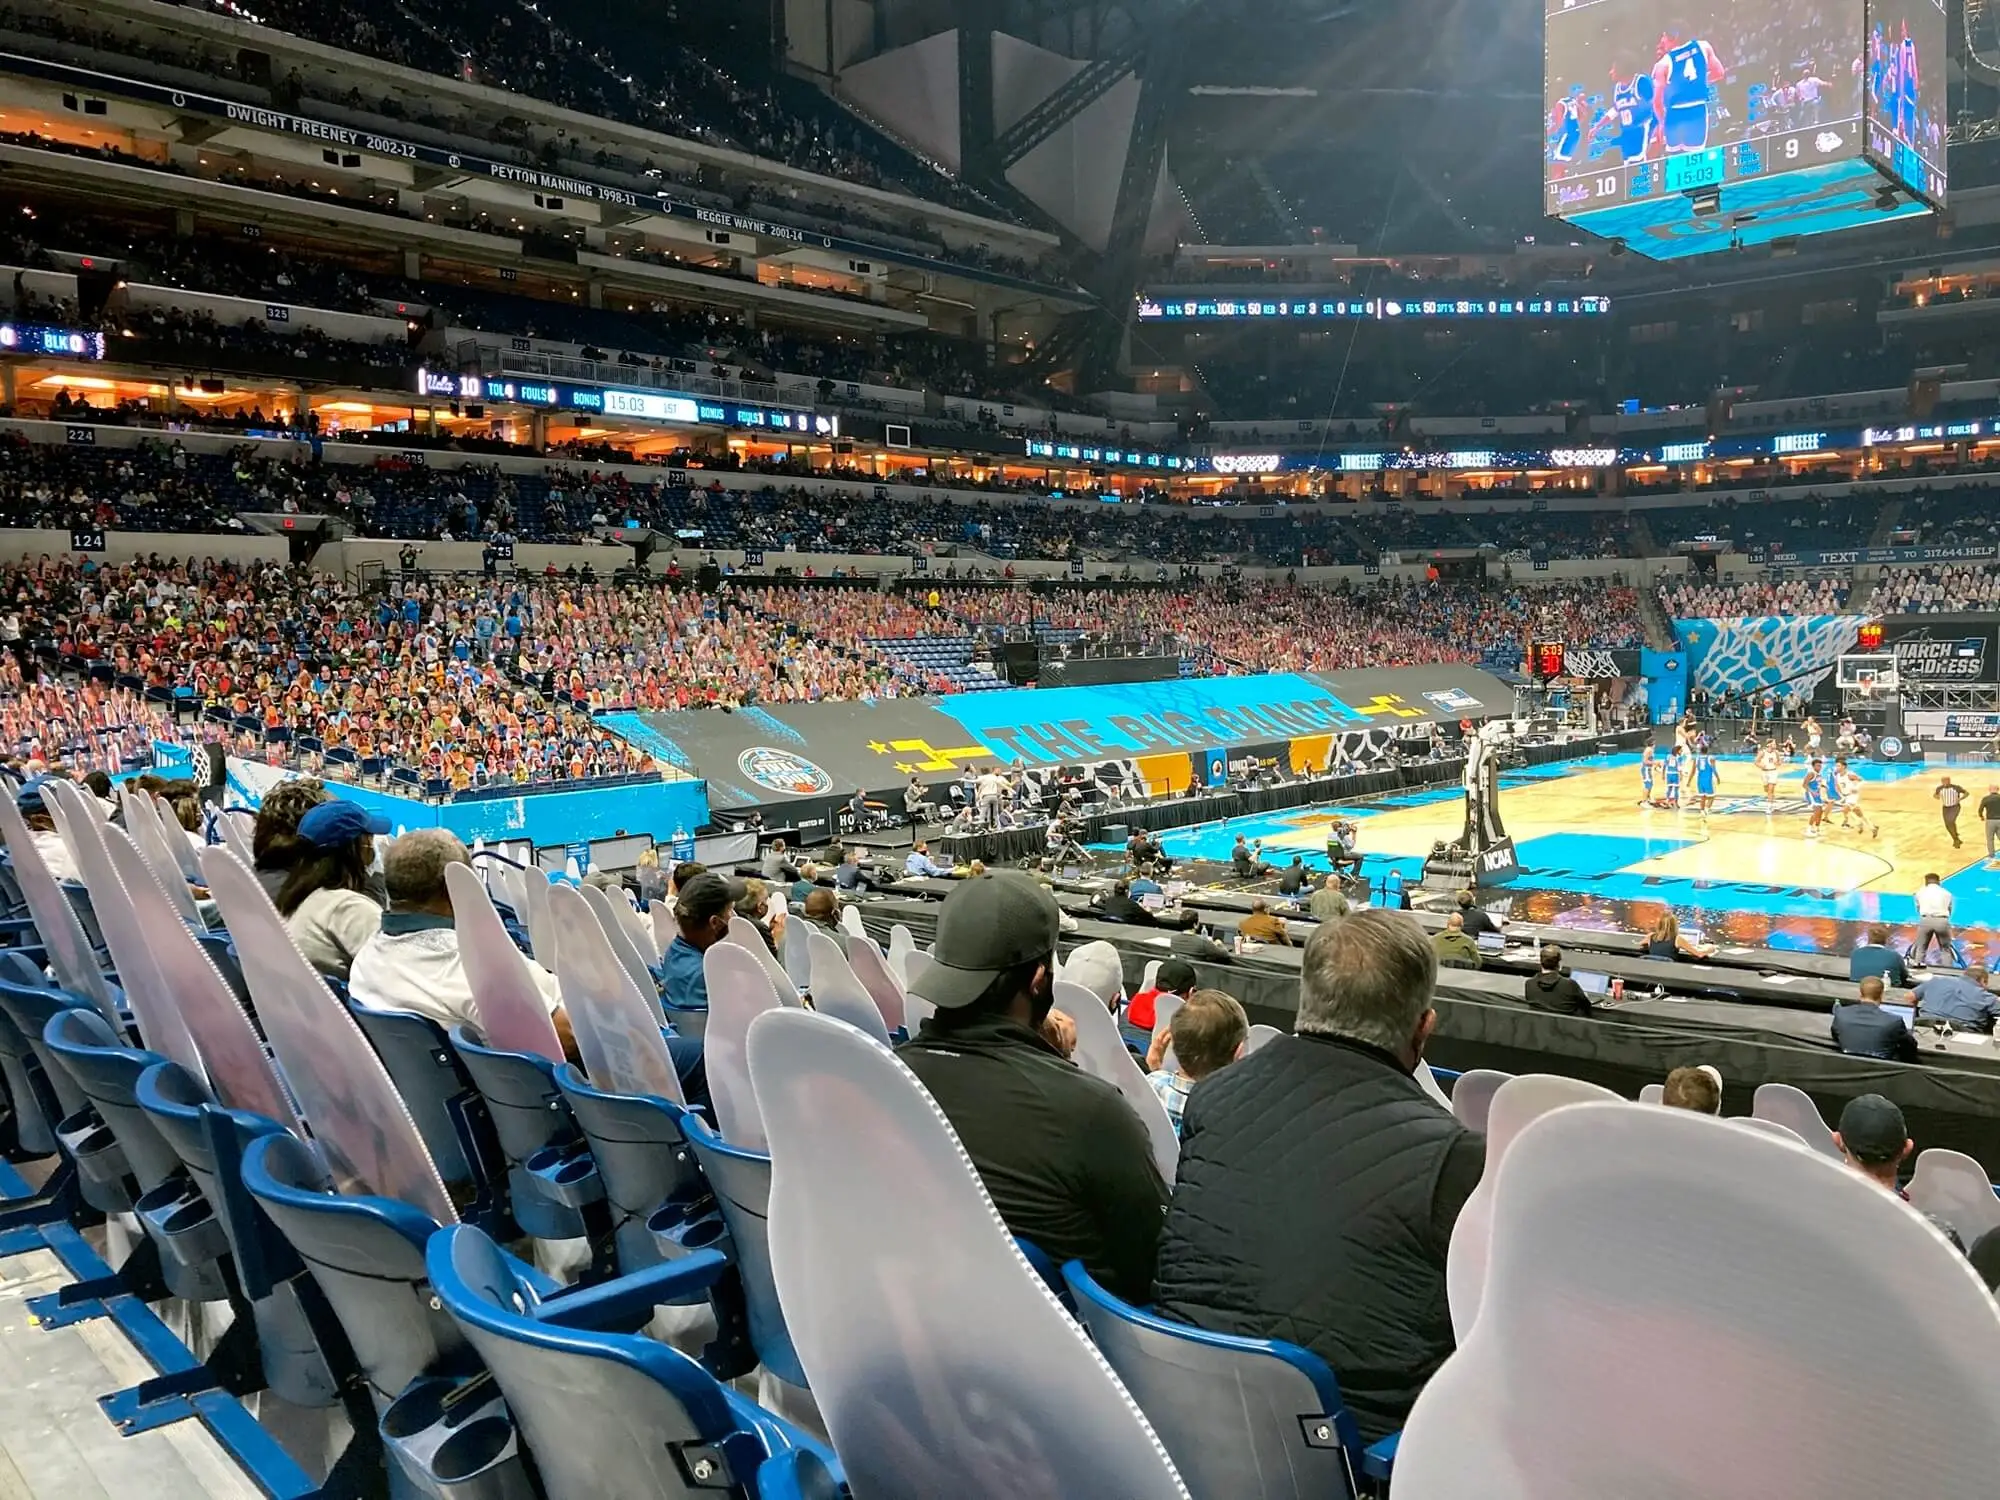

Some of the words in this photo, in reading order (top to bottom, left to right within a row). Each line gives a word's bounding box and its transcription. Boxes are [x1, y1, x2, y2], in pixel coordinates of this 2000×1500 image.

[1683, 57, 1698, 81] 4
[227, 104, 288, 130] DWIGHT
[292, 119, 358, 145] FREENEY
[366, 136, 417, 159] 2002-12
[1785, 139, 1799, 158] 9
[1676, 167, 1714, 187] 15:03
[491, 164, 538, 185] PEYTON
[540, 174, 594, 198] MANNING
[599, 187, 637, 207] 1998-11
[1595, 175, 1617, 197] 10
[697, 209, 733, 228] REGGIE
[734, 217, 767, 233] WAYNE
[771, 227, 803, 242] 2001-14
[267, 307, 288, 319] 325
[1185, 303, 1197, 315] 57
[1248, 303, 1261, 315] 50
[1337, 302, 1345, 315] 0
[1366, 302, 1373, 315] 0
[1423, 301, 1435, 314] 50
[1488, 302, 1496, 314] 0
[1516, 302, 1523, 313] 4
[1530, 303, 1541, 313] AST
[1599, 301, 1607, 313] 0
[44, 333, 68, 350] BLK
[69, 334, 83, 353] 0
[459, 377, 479, 397] 10
[488, 382, 504, 396] TOL
[521, 386, 546, 400] FOULS
[573, 391, 600, 407] BONUS
[611, 394, 644, 412] 15:03
[701, 405, 724, 420] BONUS
[738, 410, 757, 426] FOULS
[771, 413, 783, 427] TOL
[798, 415, 807, 431] 9
[68, 430, 92, 441] 224
[1897, 427, 1914, 440] 10
[405, 452, 423, 464] 225
[74, 535, 102, 548] 124
[747, 553, 762, 564] 126
[915, 559, 926, 568] 127
[1820, 551, 1859, 563] TEXT
[1540, 646, 1563, 656] 15:03
[1893, 643, 1952, 659] MARCH
[1542, 656, 1559, 673] 30
[981, 719, 1104, 765] THE
[1107, 710, 1205, 750] BIG
[1203, 699, 1348, 742] DANCE
[1483, 848, 1513, 872] NCAA
